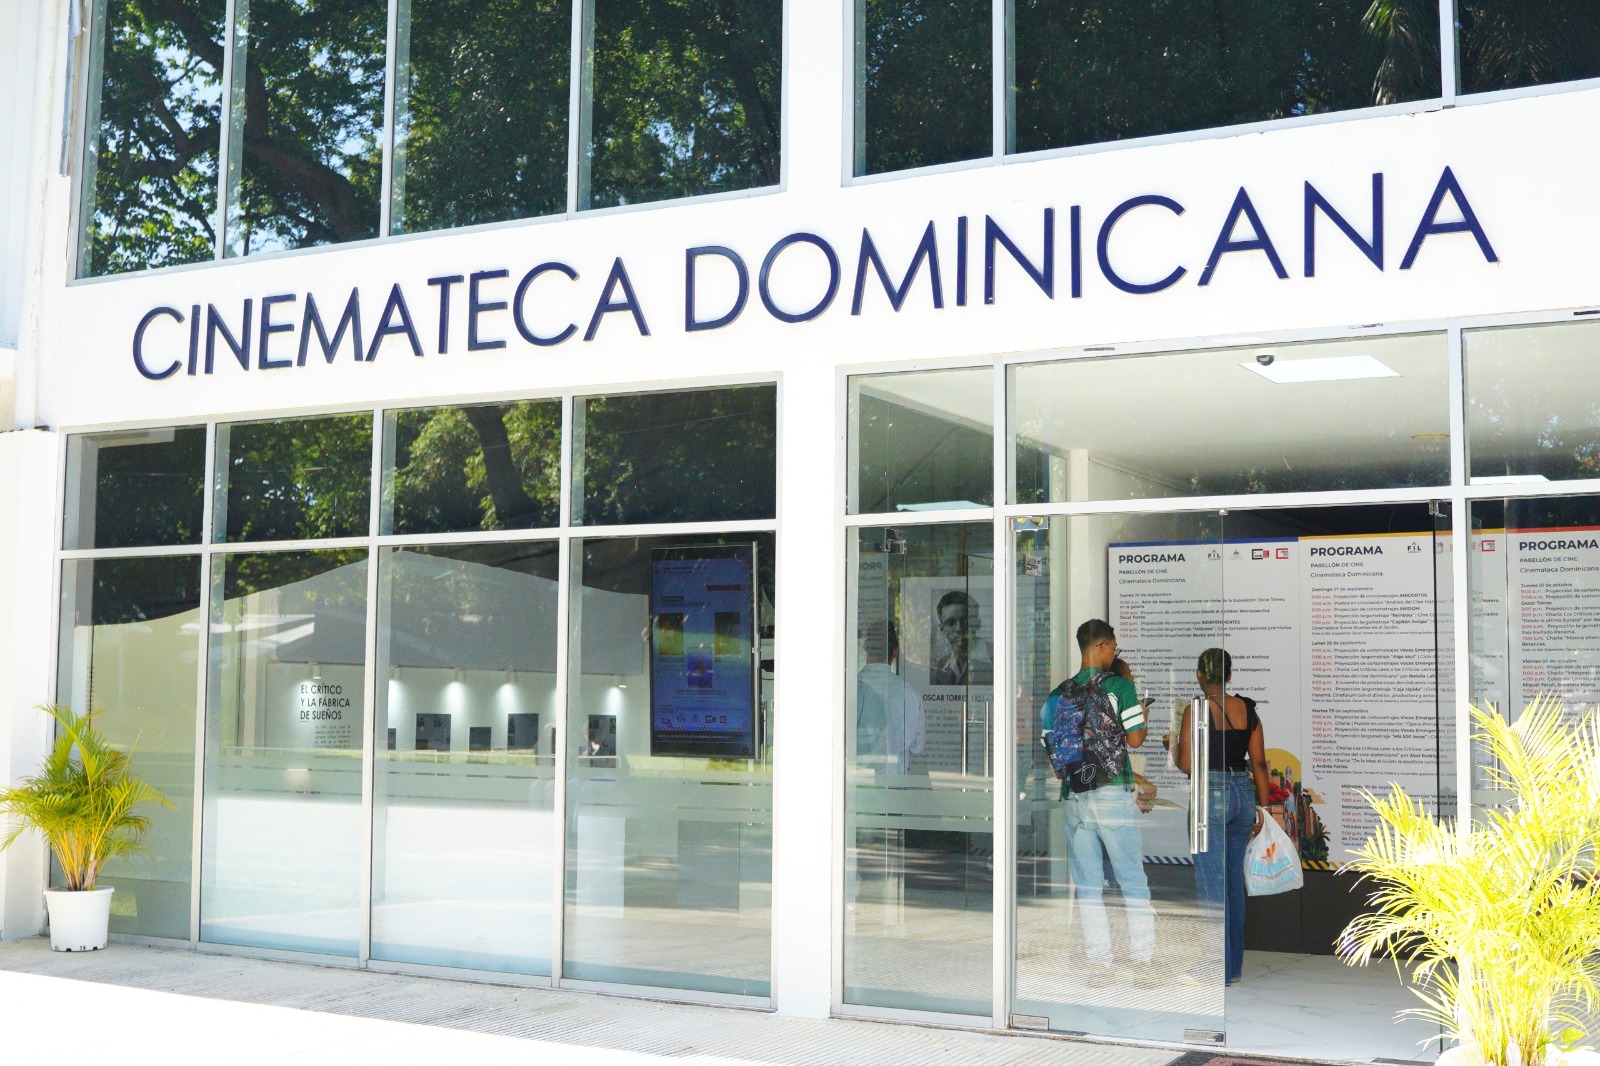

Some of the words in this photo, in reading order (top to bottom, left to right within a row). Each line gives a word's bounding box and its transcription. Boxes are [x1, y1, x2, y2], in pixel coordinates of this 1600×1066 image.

[132, 256, 651, 381] CINEMATECA
[685, 165, 1499, 333] DOMINICANA
[1519, 539, 1599, 551] PROGRAMA
[1310, 546, 1383, 556] PROGRAMA
[1119, 554, 1186, 563] PROGRAMA
[301, 685, 308, 694] EL
[311, 683, 342, 694] CRÍTICO
[300, 698, 305, 707] Y
[308, 698, 316, 707] LA
[318, 696, 350, 707] FÁBRICA
[300, 711, 310, 720] DE
[312, 709, 342, 720] SUEÑOS
